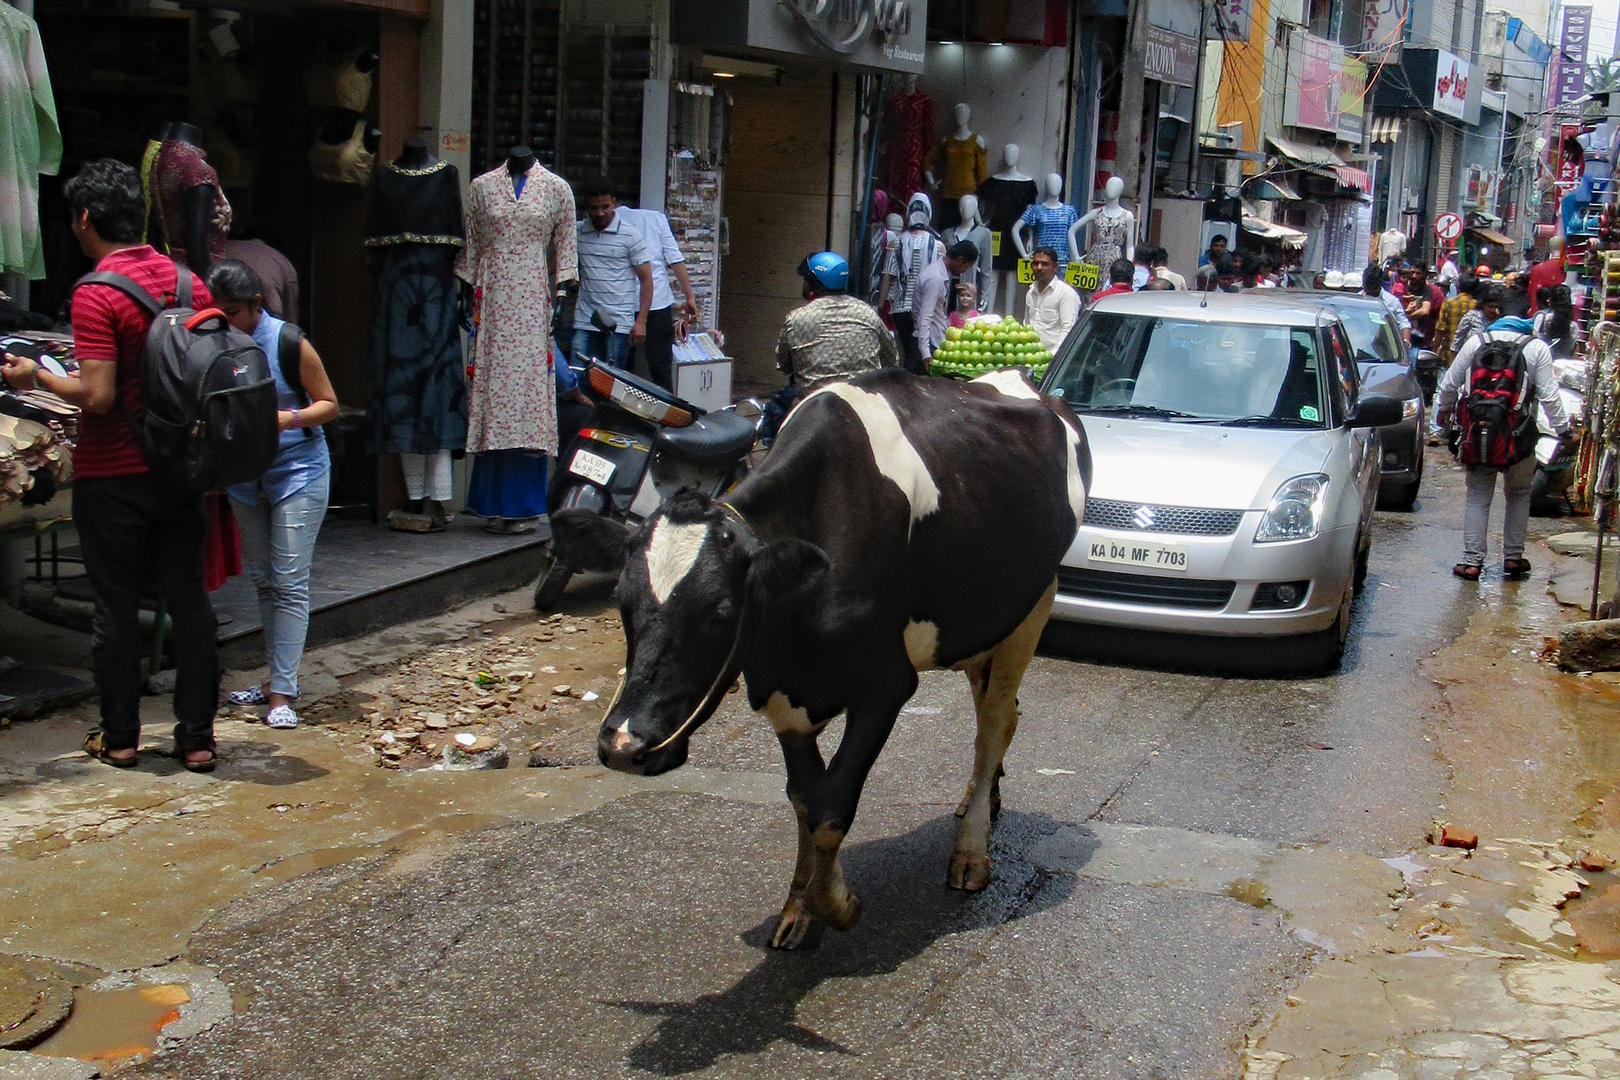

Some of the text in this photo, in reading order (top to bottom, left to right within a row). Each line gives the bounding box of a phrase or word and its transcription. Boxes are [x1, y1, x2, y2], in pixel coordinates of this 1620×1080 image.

[883, 42, 925, 63] Veg Restaurant
[1144, 41, 1178, 76] ENOWN
[1067, 263, 1098, 275] Long Dress
[1072, 274, 1096, 289] 500
[581, 454, 607, 469] KA 05
[1091, 543, 1186, 566] KA 04 MF 7703
